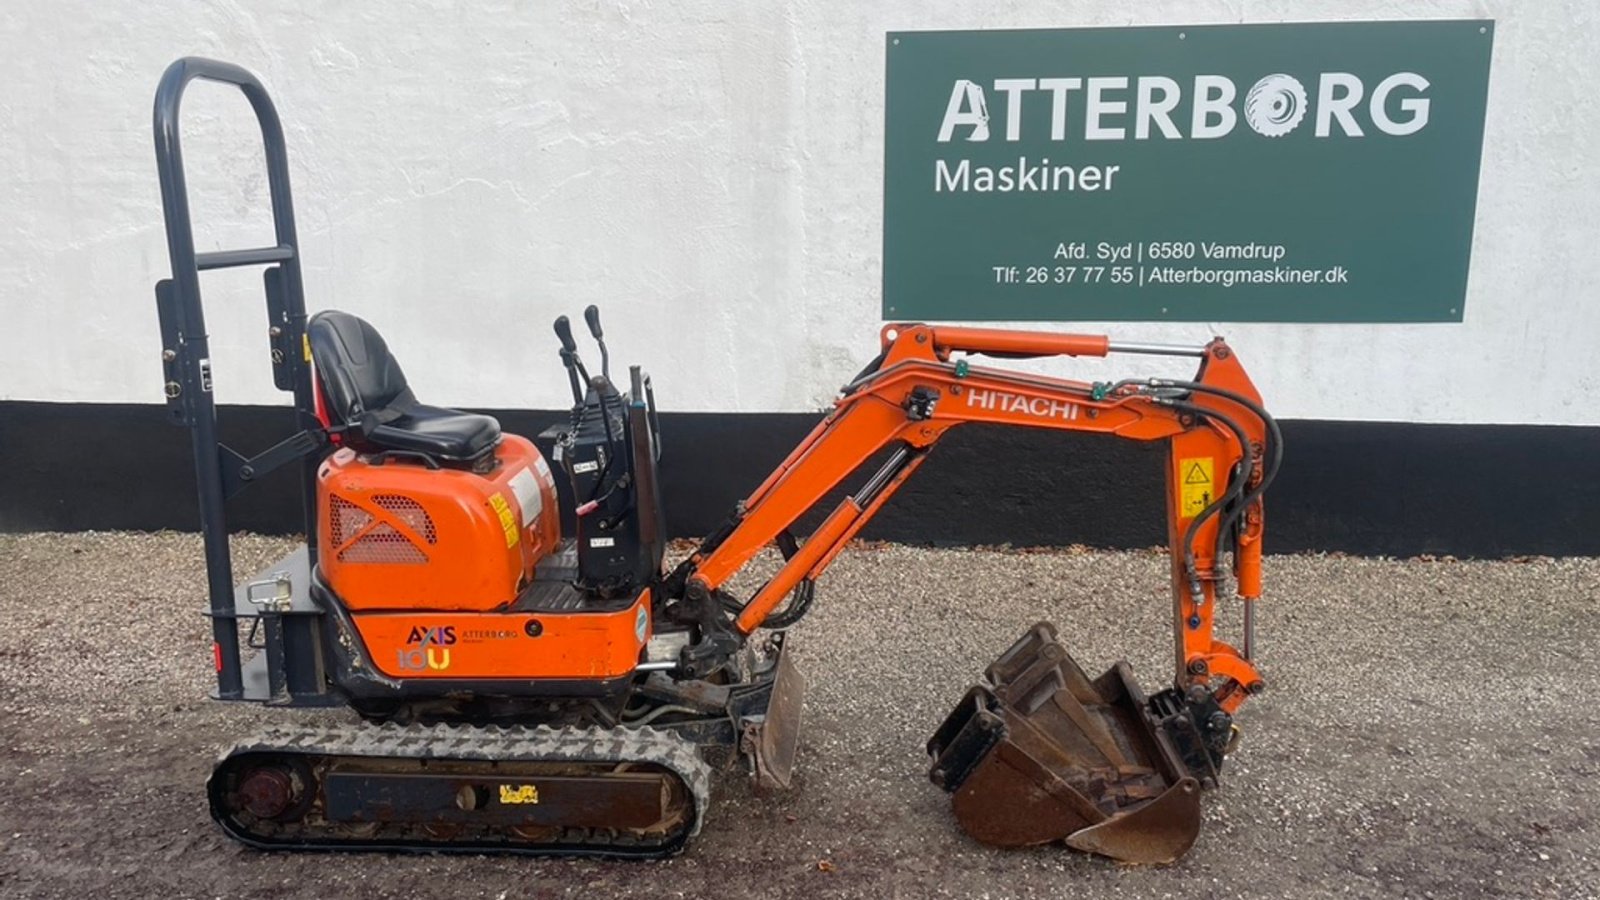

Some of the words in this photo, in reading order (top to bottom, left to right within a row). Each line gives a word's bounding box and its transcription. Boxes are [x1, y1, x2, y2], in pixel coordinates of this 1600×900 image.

[936, 71, 1431, 143] ATTERBORG
[935, 157, 1120, 192] Maskiner
[1054, 242, 1090, 260] Afd.
[1097, 242, 1132, 263] Syd
[1148, 241, 1195, 259] 6580
[1201, 241, 1286, 263] Vamdrup
[992, 266, 1020, 283] Tlf:
[1026, 266, 1048, 283] 26
[1055, 266, 1077, 283] 37
[1083, 266, 1105, 283] 77
[1111, 266, 1133, 283] 55
[1148, 265, 1348, 288] Atterborgmaskiner.dk
[967, 388, 1079, 420] HITACHI
[406, 625, 457, 647] AXIS
[397, 648, 450, 670] 10U
